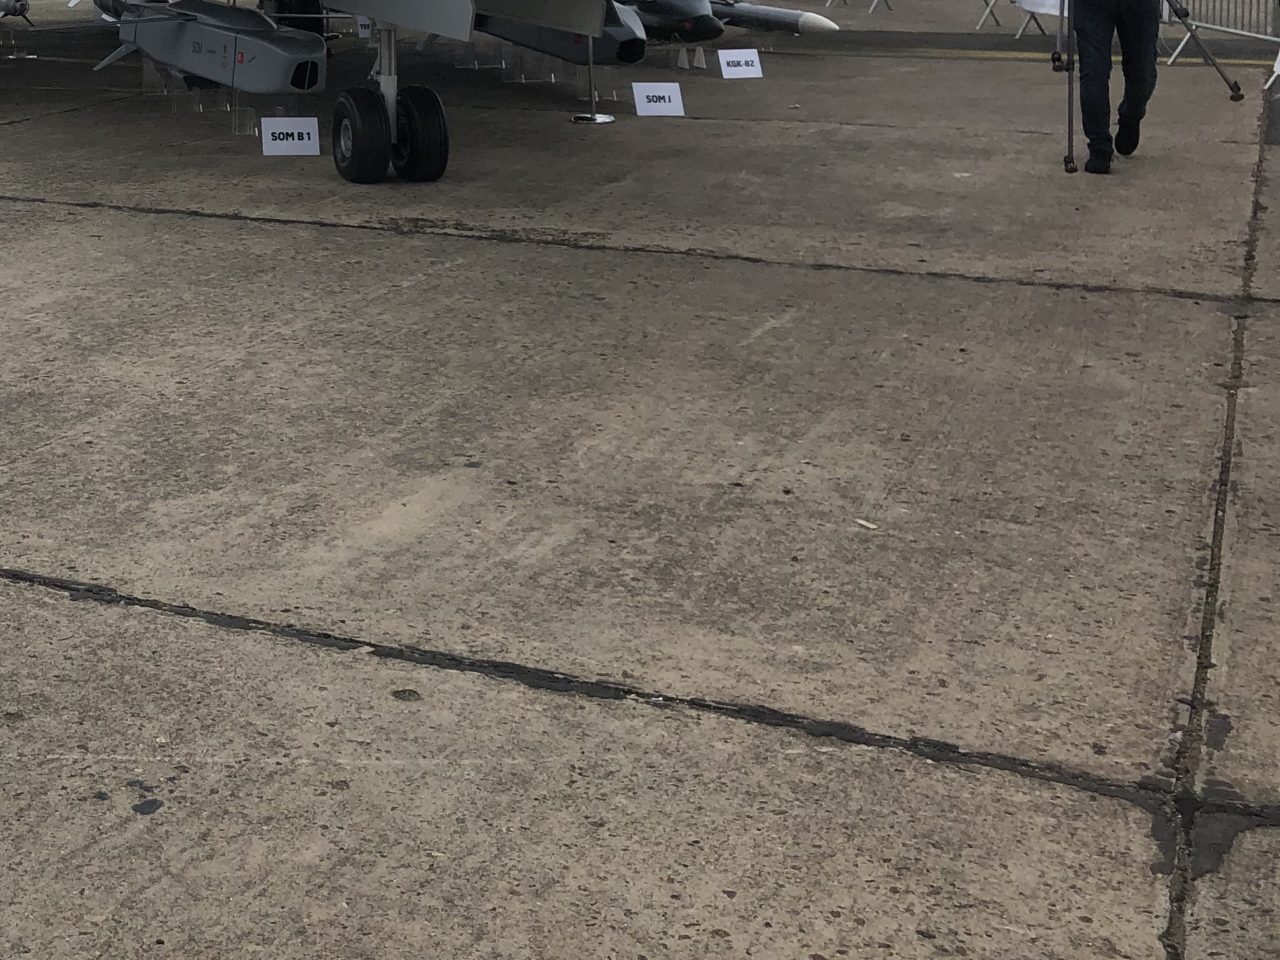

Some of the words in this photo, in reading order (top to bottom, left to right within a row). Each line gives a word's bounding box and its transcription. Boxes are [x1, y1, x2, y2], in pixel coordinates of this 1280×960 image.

[726, 60, 755, 68] KGK-82
[646, 94, 666, 104] SOM
[271, 132, 295, 141] SOM
[298, 132, 304, 141] B
[306, 132, 311, 141] 1
